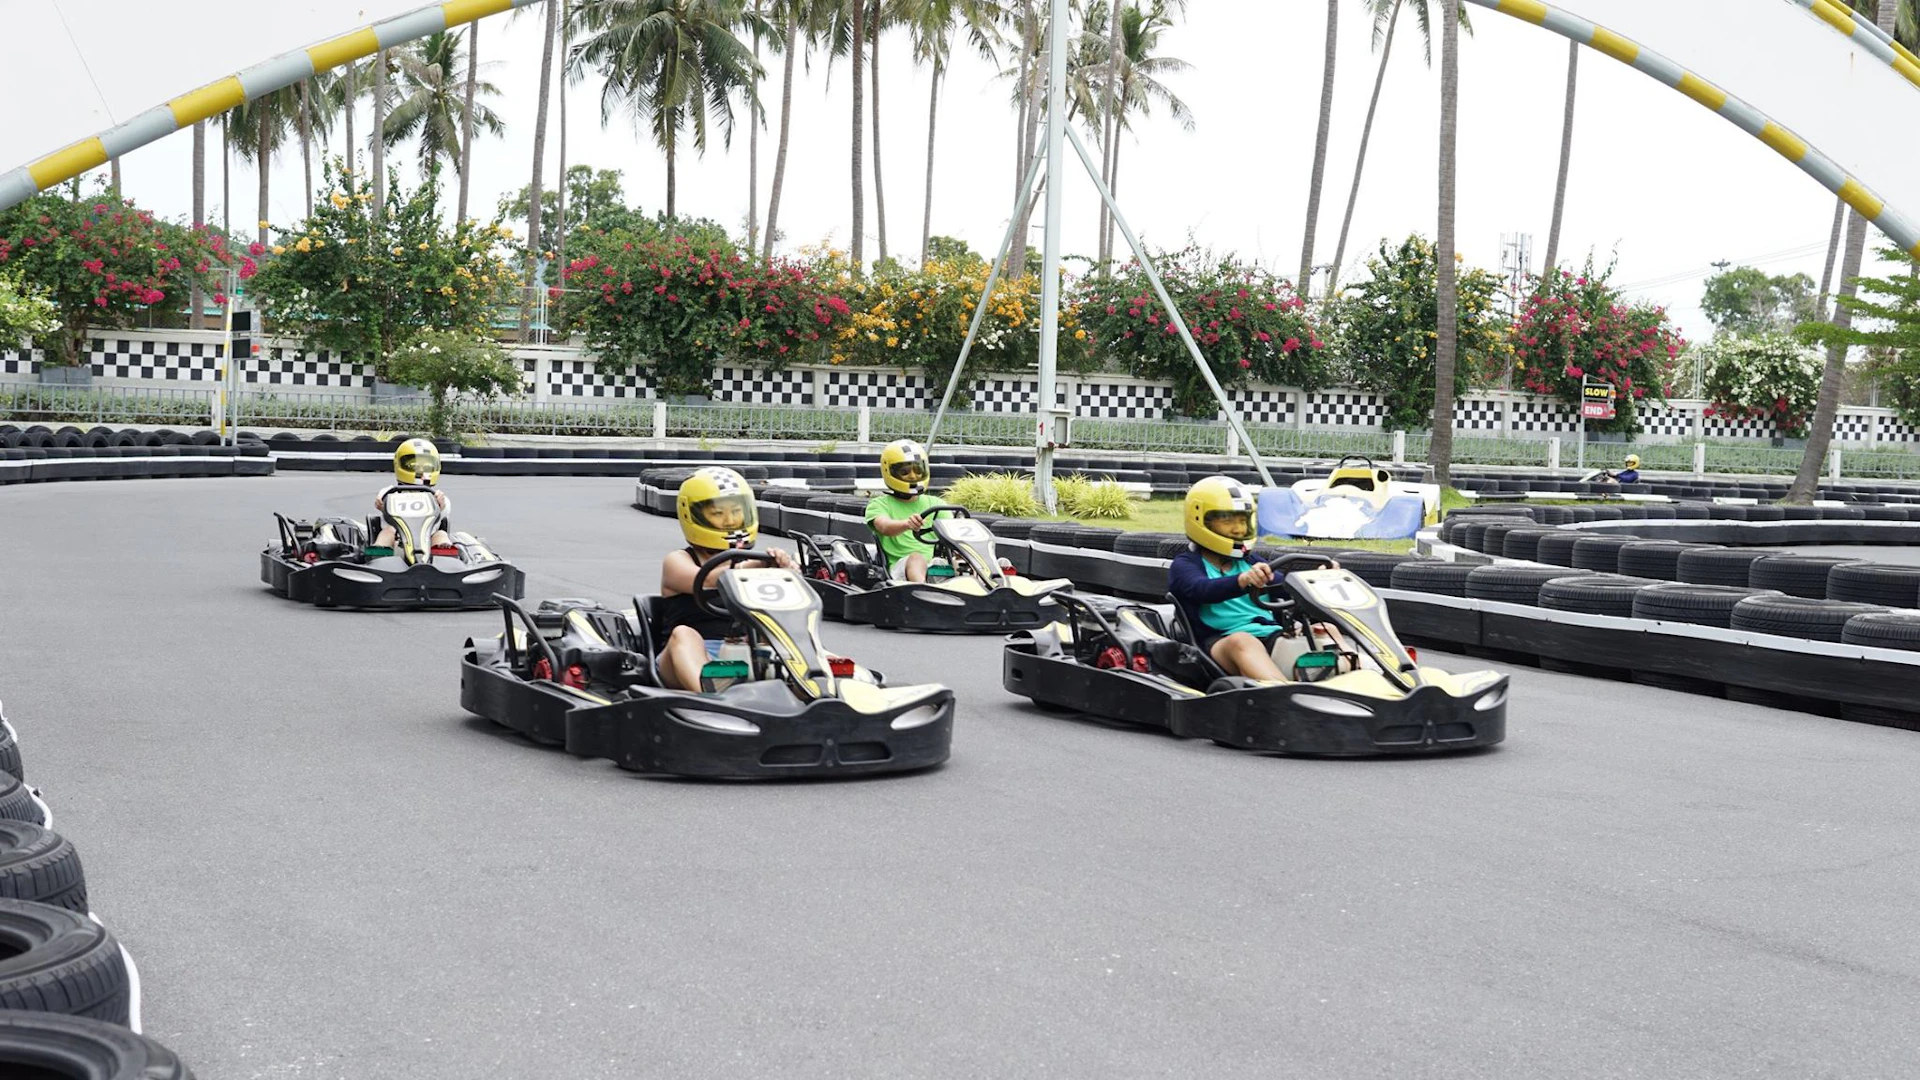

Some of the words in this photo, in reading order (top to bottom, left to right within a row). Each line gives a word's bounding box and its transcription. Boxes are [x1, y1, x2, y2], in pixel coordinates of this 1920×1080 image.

[1585, 388, 1608, 397] SLOW
[1585, 406, 1603, 415] END
[1039, 421, 1044, 436] 1
[398, 501, 424, 511] 10
[959, 526, 975, 537] 2
[757, 583, 785, 601] 9
[1330, 583, 1350, 601] 1
